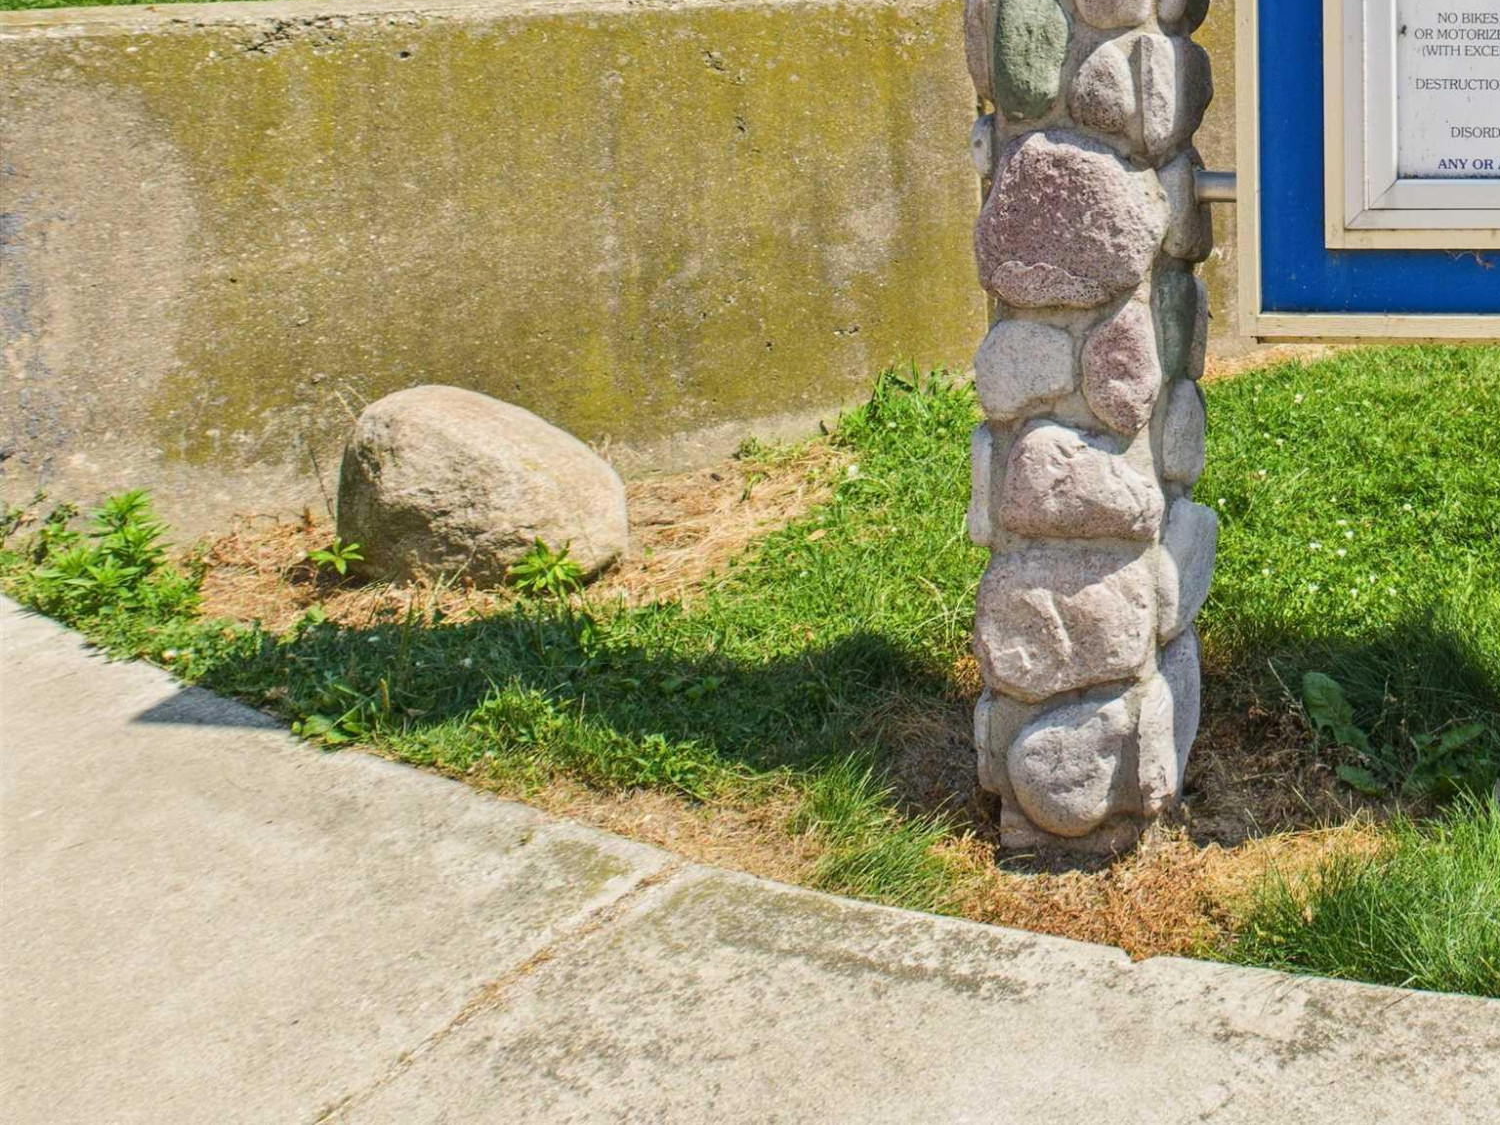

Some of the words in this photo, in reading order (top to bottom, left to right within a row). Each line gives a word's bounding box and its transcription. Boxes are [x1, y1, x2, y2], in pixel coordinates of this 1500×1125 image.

[1438, 13, 1458, 23] NO
[1414, 28, 1433, 39] OR
[1422, 45, 1460, 56] (WITH
[1437, 158, 1469, 170] ANY
[1472, 158, 1494, 171] OR
